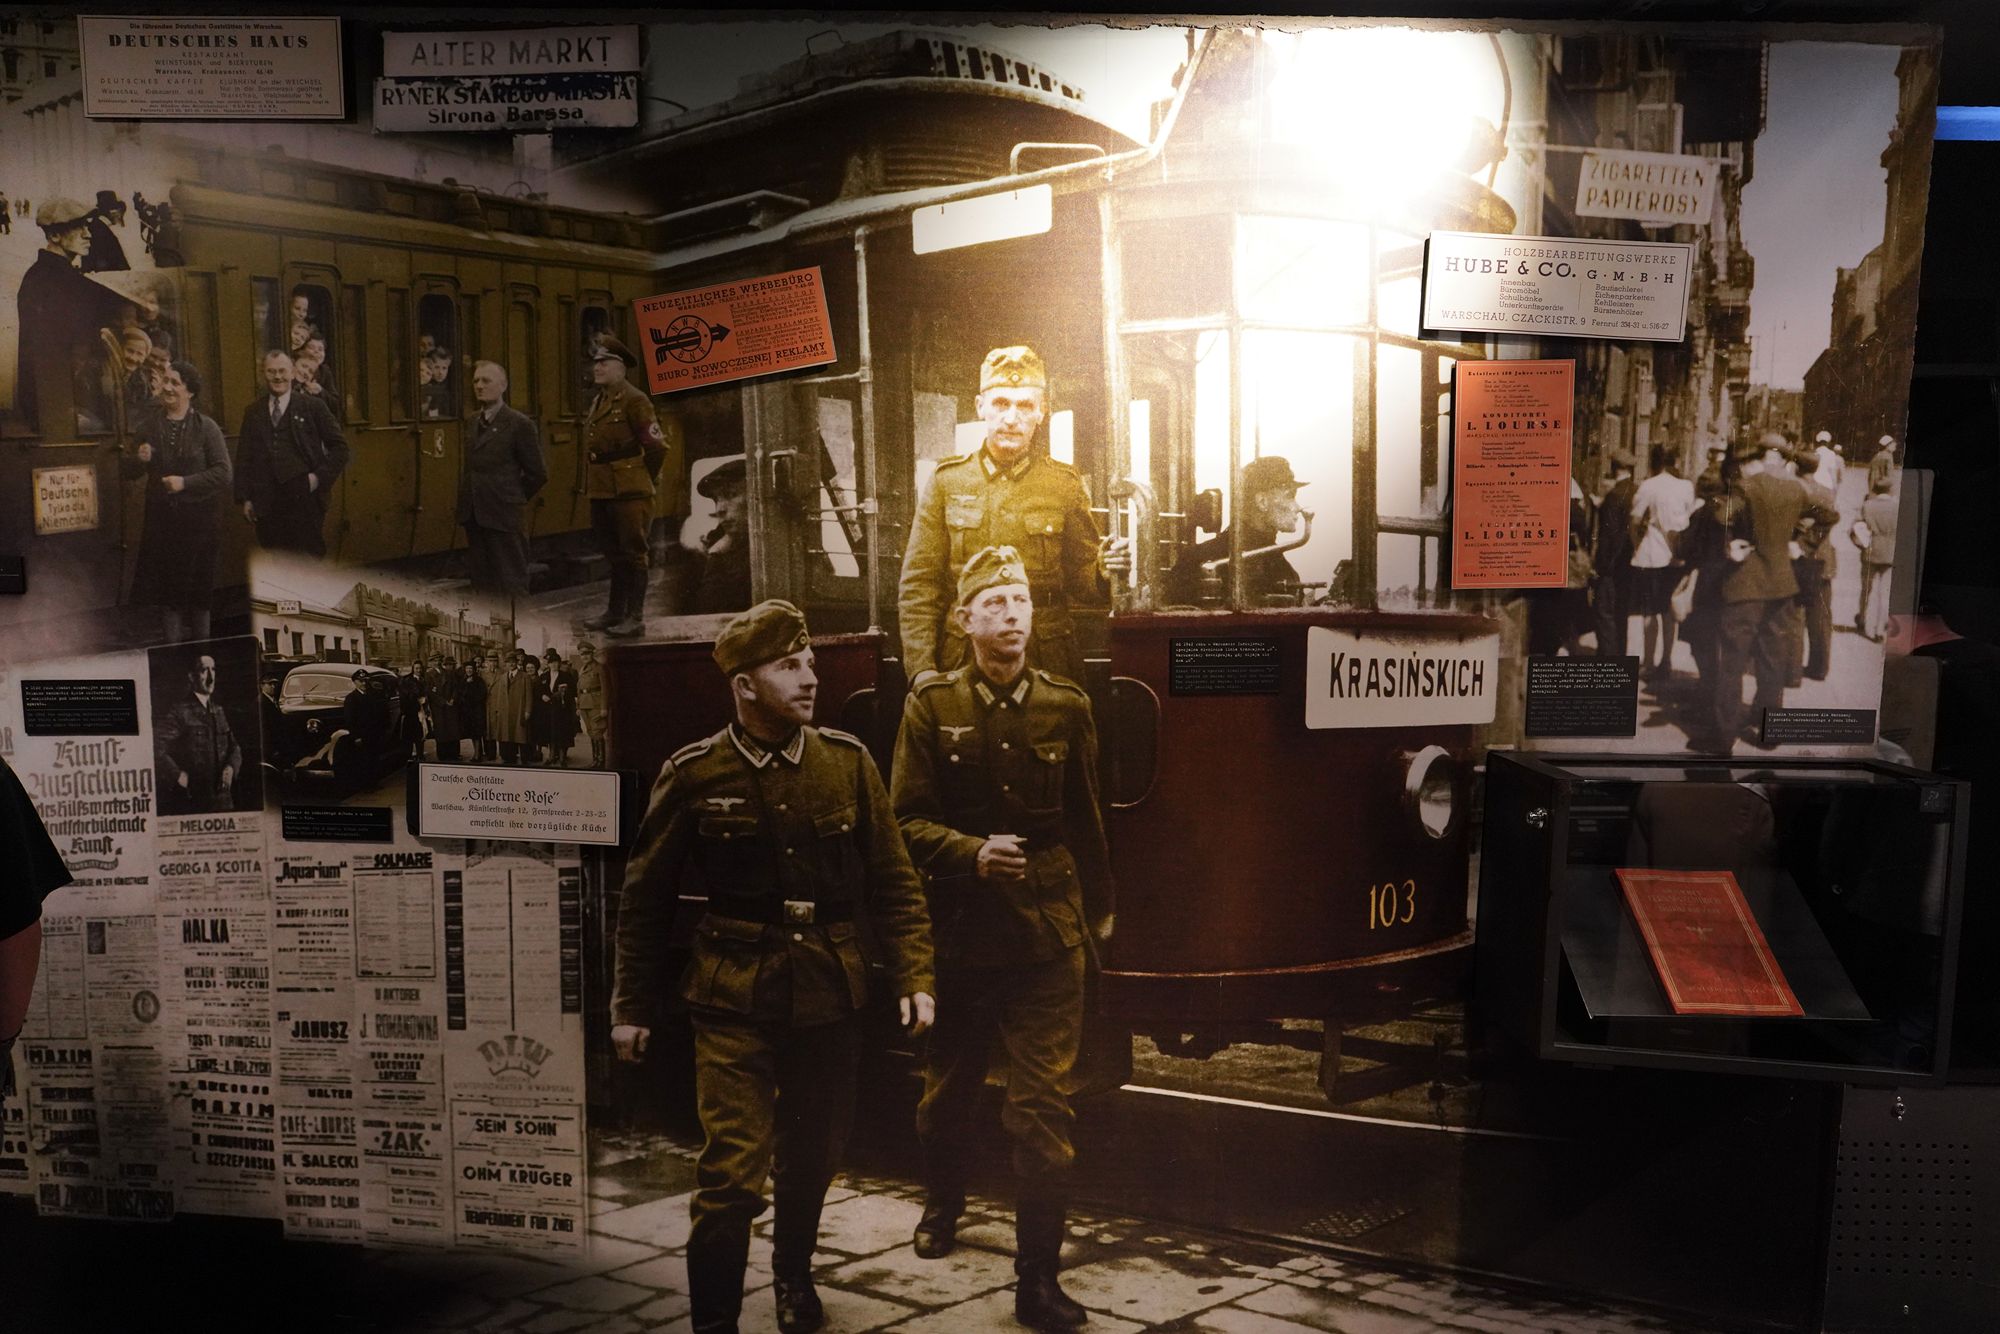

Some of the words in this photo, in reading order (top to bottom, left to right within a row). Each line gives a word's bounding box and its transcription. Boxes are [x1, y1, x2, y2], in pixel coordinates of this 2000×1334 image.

[109, 34, 238, 48] DEUTSCHES
[250, 34, 308, 48] HAUS
[411, 41, 496, 66] ALTER
[509, 36, 611, 66] MARKT
[381, 86, 450, 106] RYNEK
[453, 84, 547, 104] STAREGO
[1590, 160, 1704, 188] ZIGARETTEN
[1586, 188, 1698, 216] PAPIEROSY
[1503, 247, 1677, 265] HOLZBEARBEITUNGSWERKE
[1444, 256, 1509, 274] HUBE
[1518, 261, 1530, 275] &
[1538, 261, 1576, 278] CO.
[1500, 278, 1536, 287] Innenbau
[1500, 285, 1540, 295] Büromöbel
[1595, 283, 1644, 293] Bautischlerei
[642, 287, 737, 313] NEUZEITLICHES
[740, 273, 813, 295] WERBEBÜRO
[1499, 293, 1543, 303] Schulbänke
[1594, 291, 1656, 302] Eichenparketten
[1499, 300, 1564, 312] Unterkunftsgeräte
[1591, 318, 1619, 328] Fernruf
[656, 368, 689, 382] BIURO
[692, 352, 773, 376] NOWOCZESNEJ
[776, 342, 826, 360] REKLAMY
[1467, 422, 1477, 431] L.
[1486, 420, 1561, 431] LOURSE
[50, 475, 64, 485] Nur
[67, 474, 80, 484] für
[41, 487, 90, 501] Deutsche
[48, 503, 70, 516] Tylko
[1464, 531, 1474, 540] L.
[1483, 529, 1558, 540] LOURSE
[1329, 651, 1486, 699] KRASIŃSKICH
[28, 768, 153, 800] Ausstellung
[431, 773, 464, 785] Deutsche
[466, 775, 505, 786] Gaststätte
[180, 818, 236, 833] MELODIA
[469, 819, 505, 831] empfiehlt
[509, 820, 524, 830] ihre
[528, 820, 578, 833] vorzügliche
[581, 823, 608, 834] Küche
[374, 852, 433, 868] SOLMARE
[159, 862, 211, 876] GEORGA
[216, 860, 262, 874] SCOTTA
[1369, 879, 1416, 930] 103
[182, 918, 230, 944] HALKA
[185, 980, 217, 989] VERDI
[226, 980, 270, 990] PUCCINI
[291, 1020, 349, 1039] JANUSZ
[29, 1049, 92, 1064] MAXIM
[308, 1088, 353, 1100] WALTER
[192, 1098, 275, 1119] MAXIM
[514, 1120, 557, 1137] SOHN
[381, 1131, 425, 1153] ZAK
[302, 1154, 359, 1169] SALECKI
[462, 1166, 502, 1184] OHM
